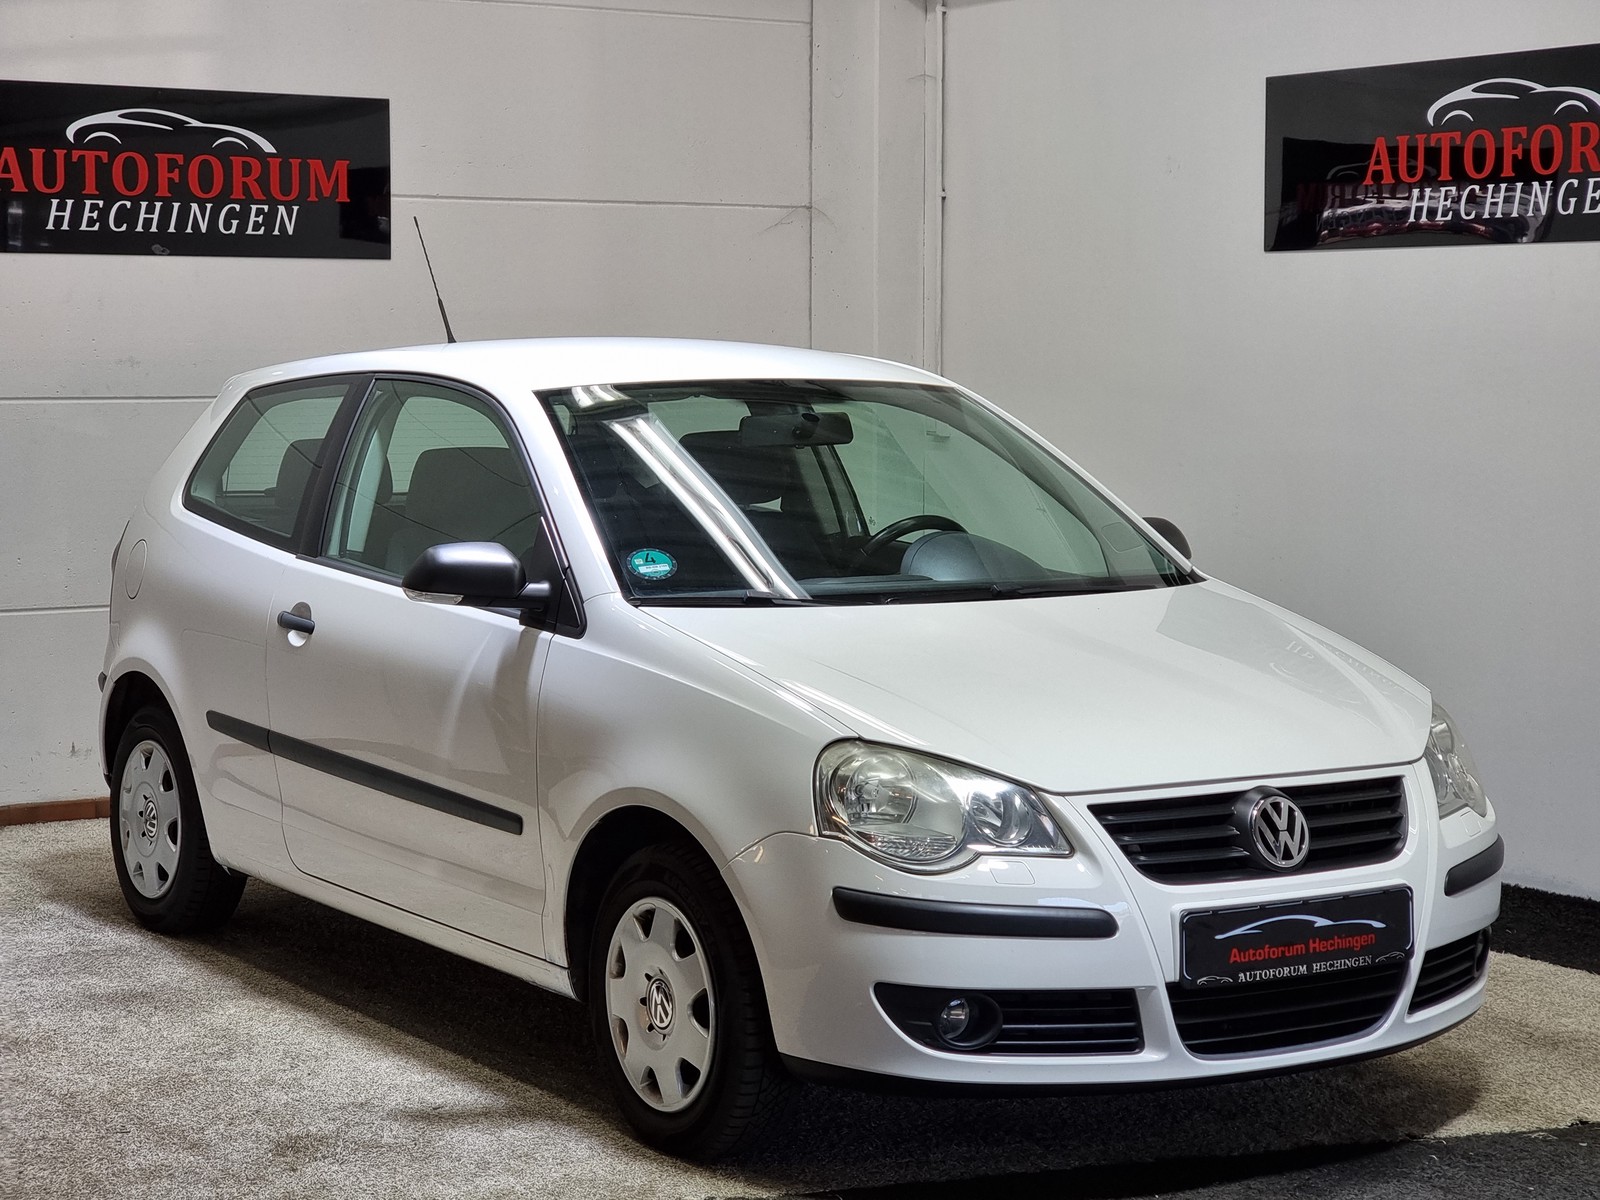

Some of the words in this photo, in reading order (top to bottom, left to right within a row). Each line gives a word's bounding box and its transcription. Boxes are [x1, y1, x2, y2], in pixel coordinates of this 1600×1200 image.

[0, 146, 350, 202] AUTOFORUM
[46, 199, 299, 235] HECHINGEN
[644, 552, 656, 563] 4
[1229, 939, 1306, 964] Autoforum
[1309, 933, 1376, 957] Hechingen
[1238, 964, 1308, 983] AUTOFORUM
[1312, 954, 1373, 973] HECHINGEN
